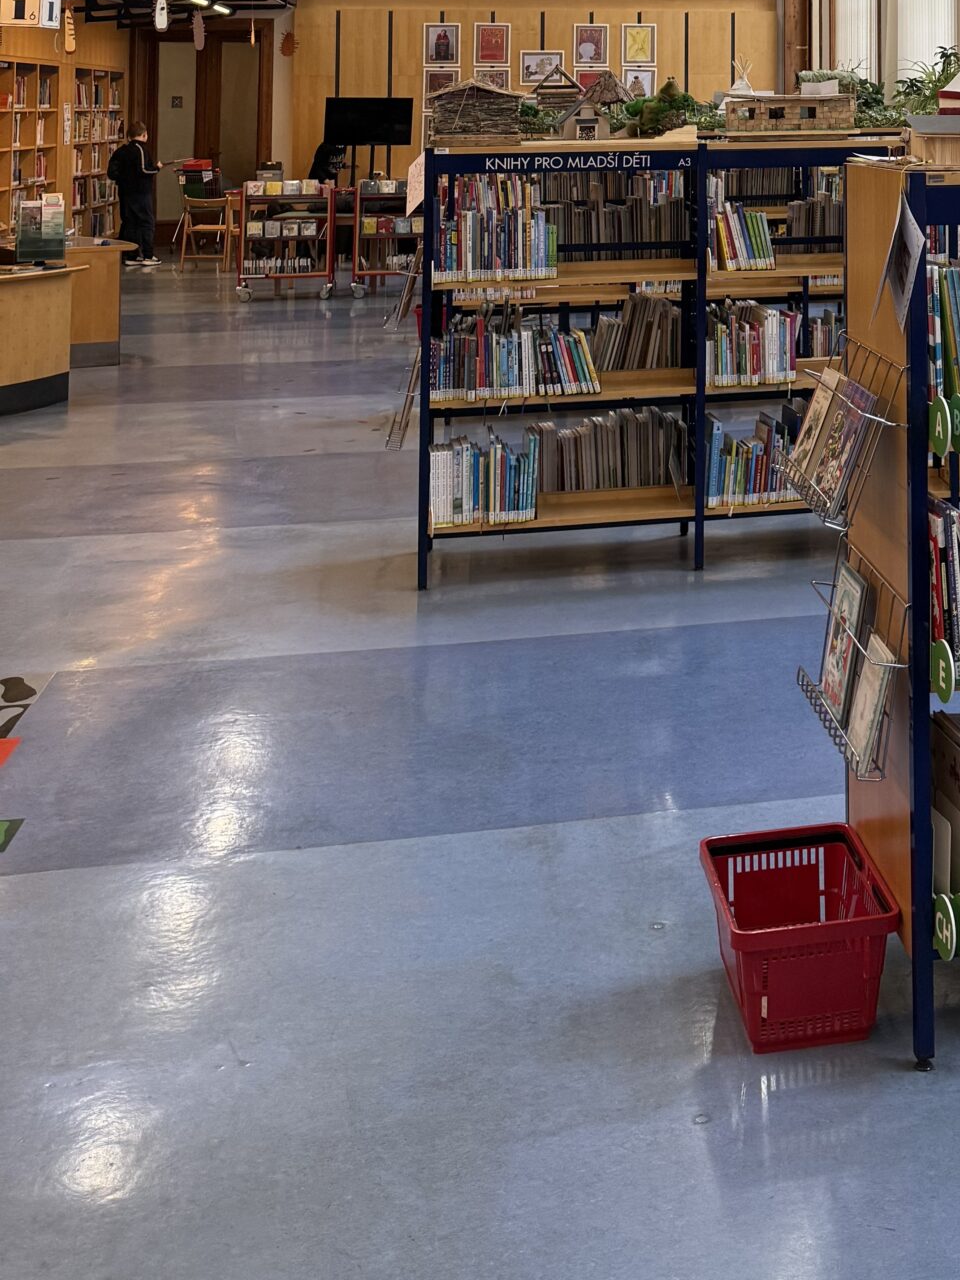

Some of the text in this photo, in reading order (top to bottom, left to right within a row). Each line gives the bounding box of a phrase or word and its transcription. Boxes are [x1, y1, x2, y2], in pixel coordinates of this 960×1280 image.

[486, 152, 691, 170] KNIHY PRO MLADŠÍ DĚTI A3
[935, 412, 943, 439] A
[953, 409, 960, 434] B
[940, 659, 946, 690] E
[936, 912, 950, 950] CH
